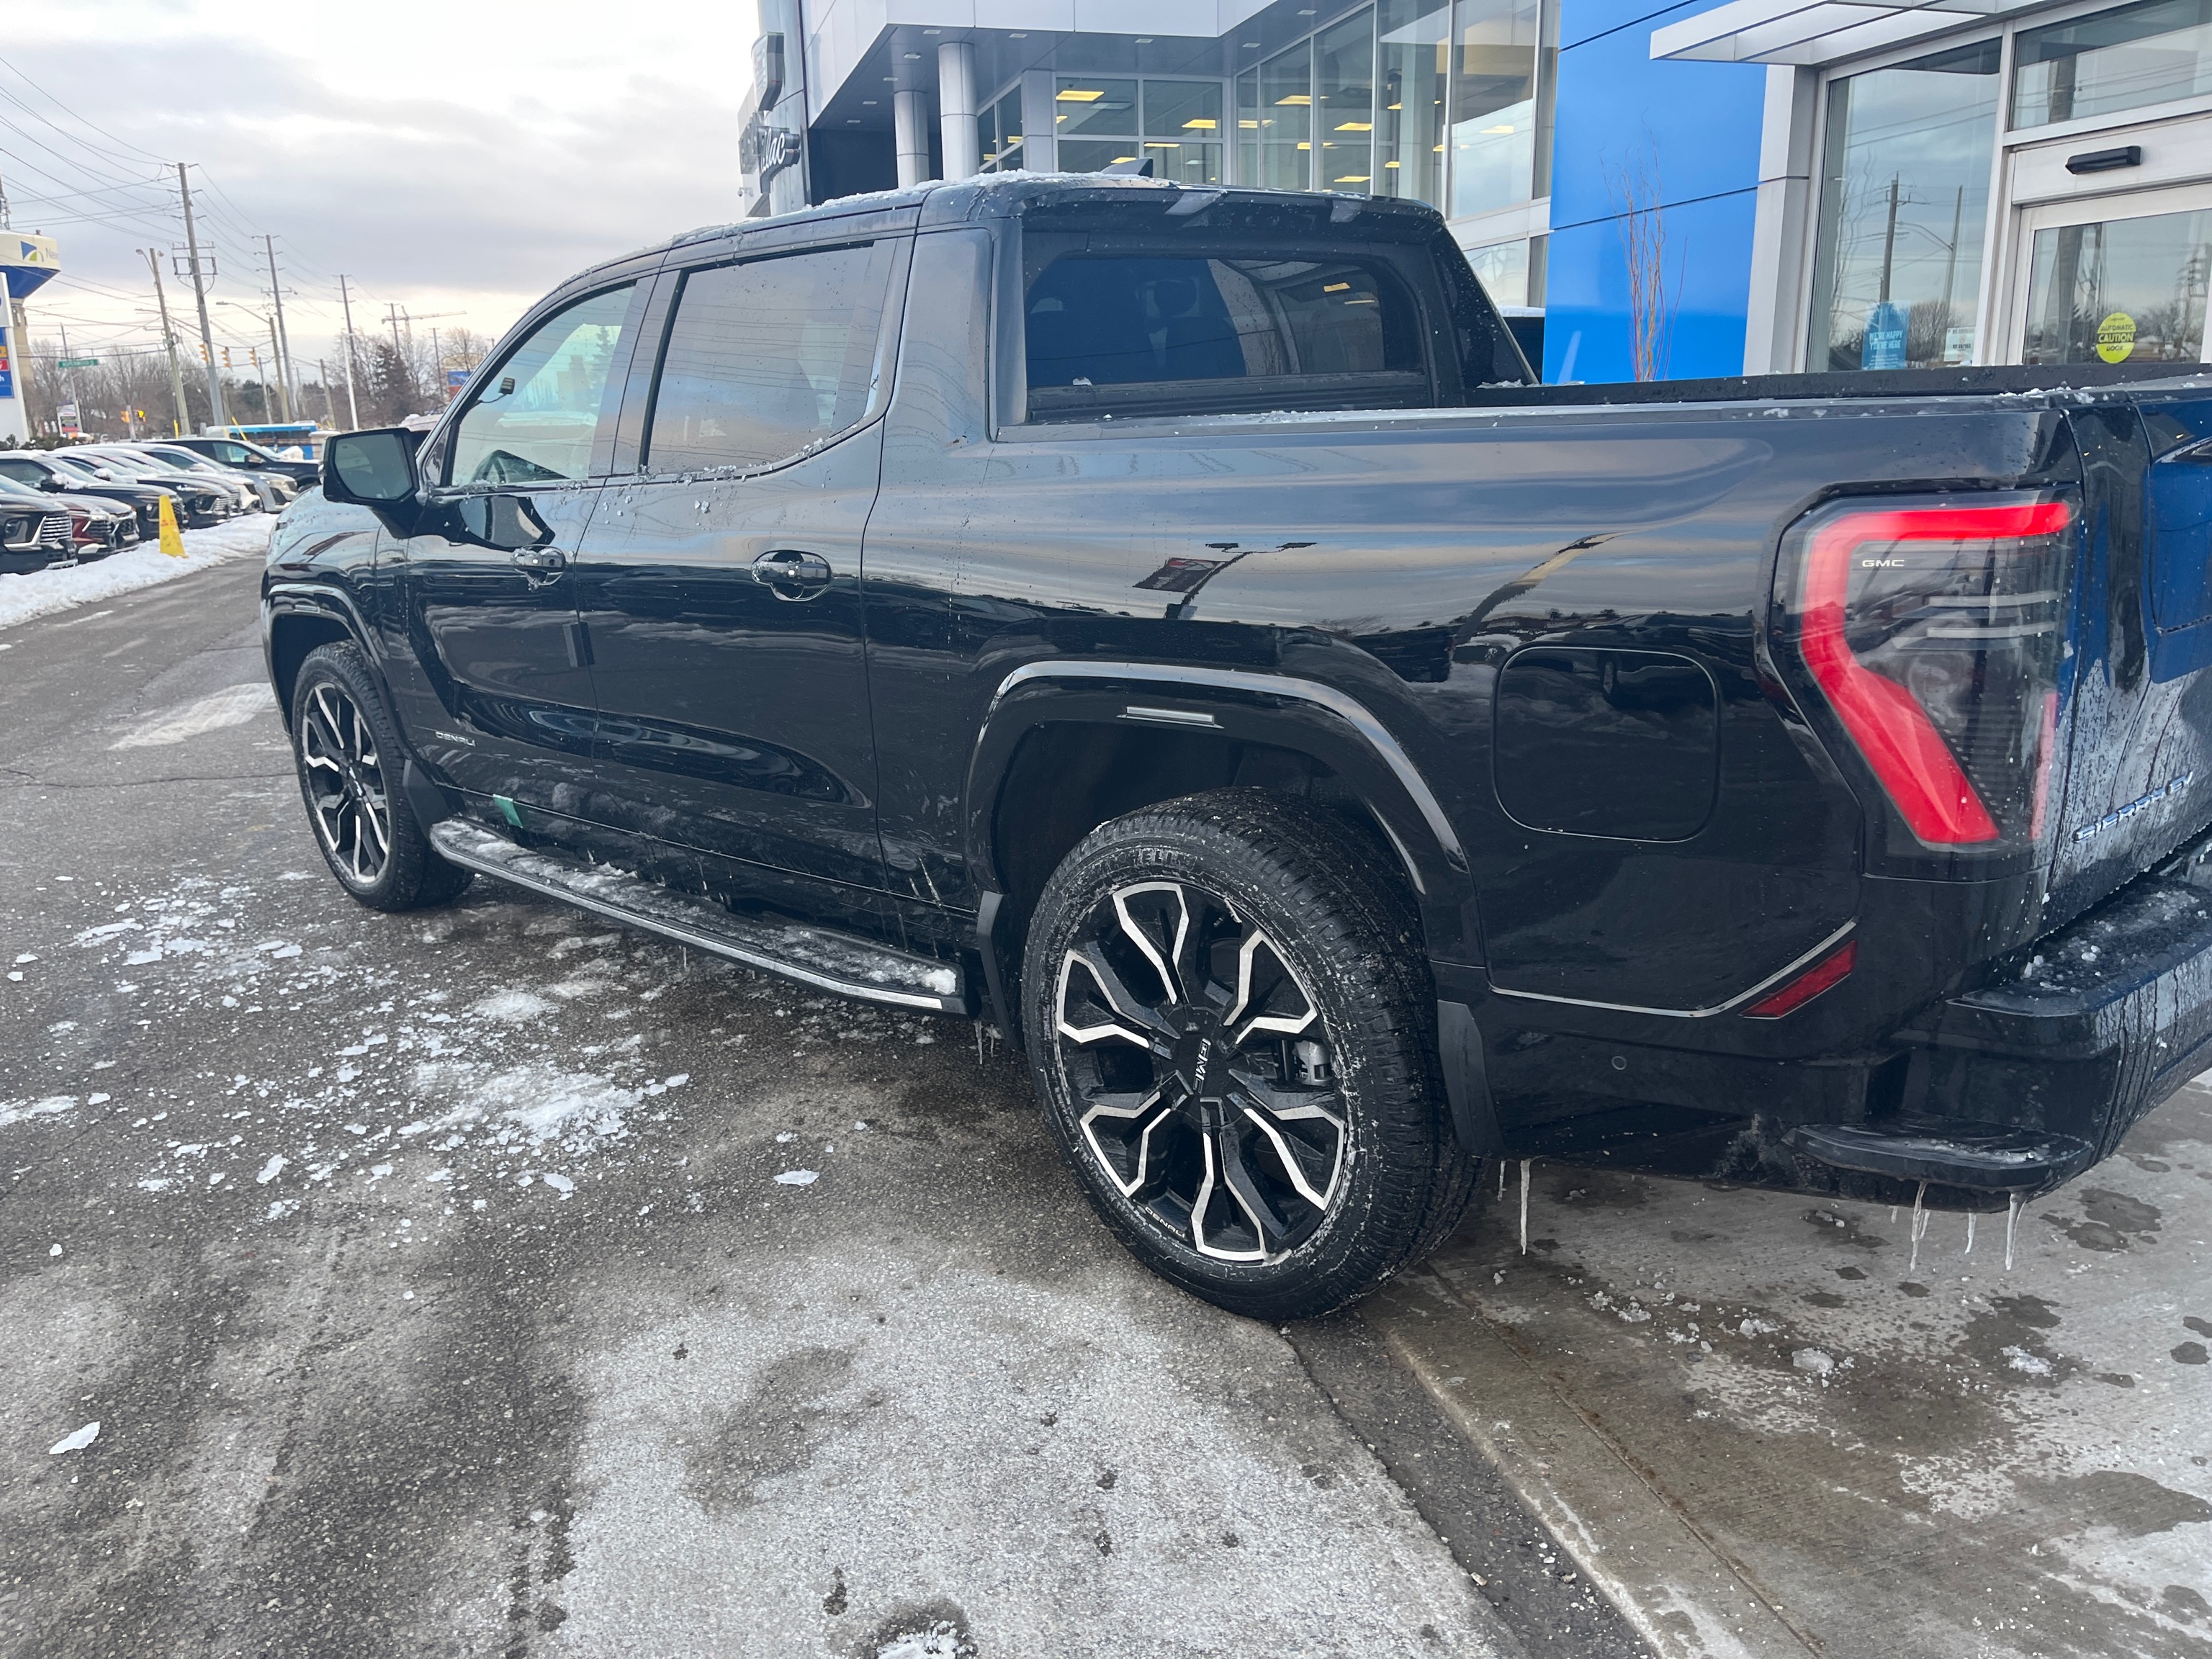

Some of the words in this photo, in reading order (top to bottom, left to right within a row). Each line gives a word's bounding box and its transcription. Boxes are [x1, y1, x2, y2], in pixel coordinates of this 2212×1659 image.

[2098, 333, 2134, 343] CAUTION
[436, 731, 476, 747] DENALI
[1193, 1038, 1212, 1094] GMC
[1145, 1206, 1185, 1238] DENALI
